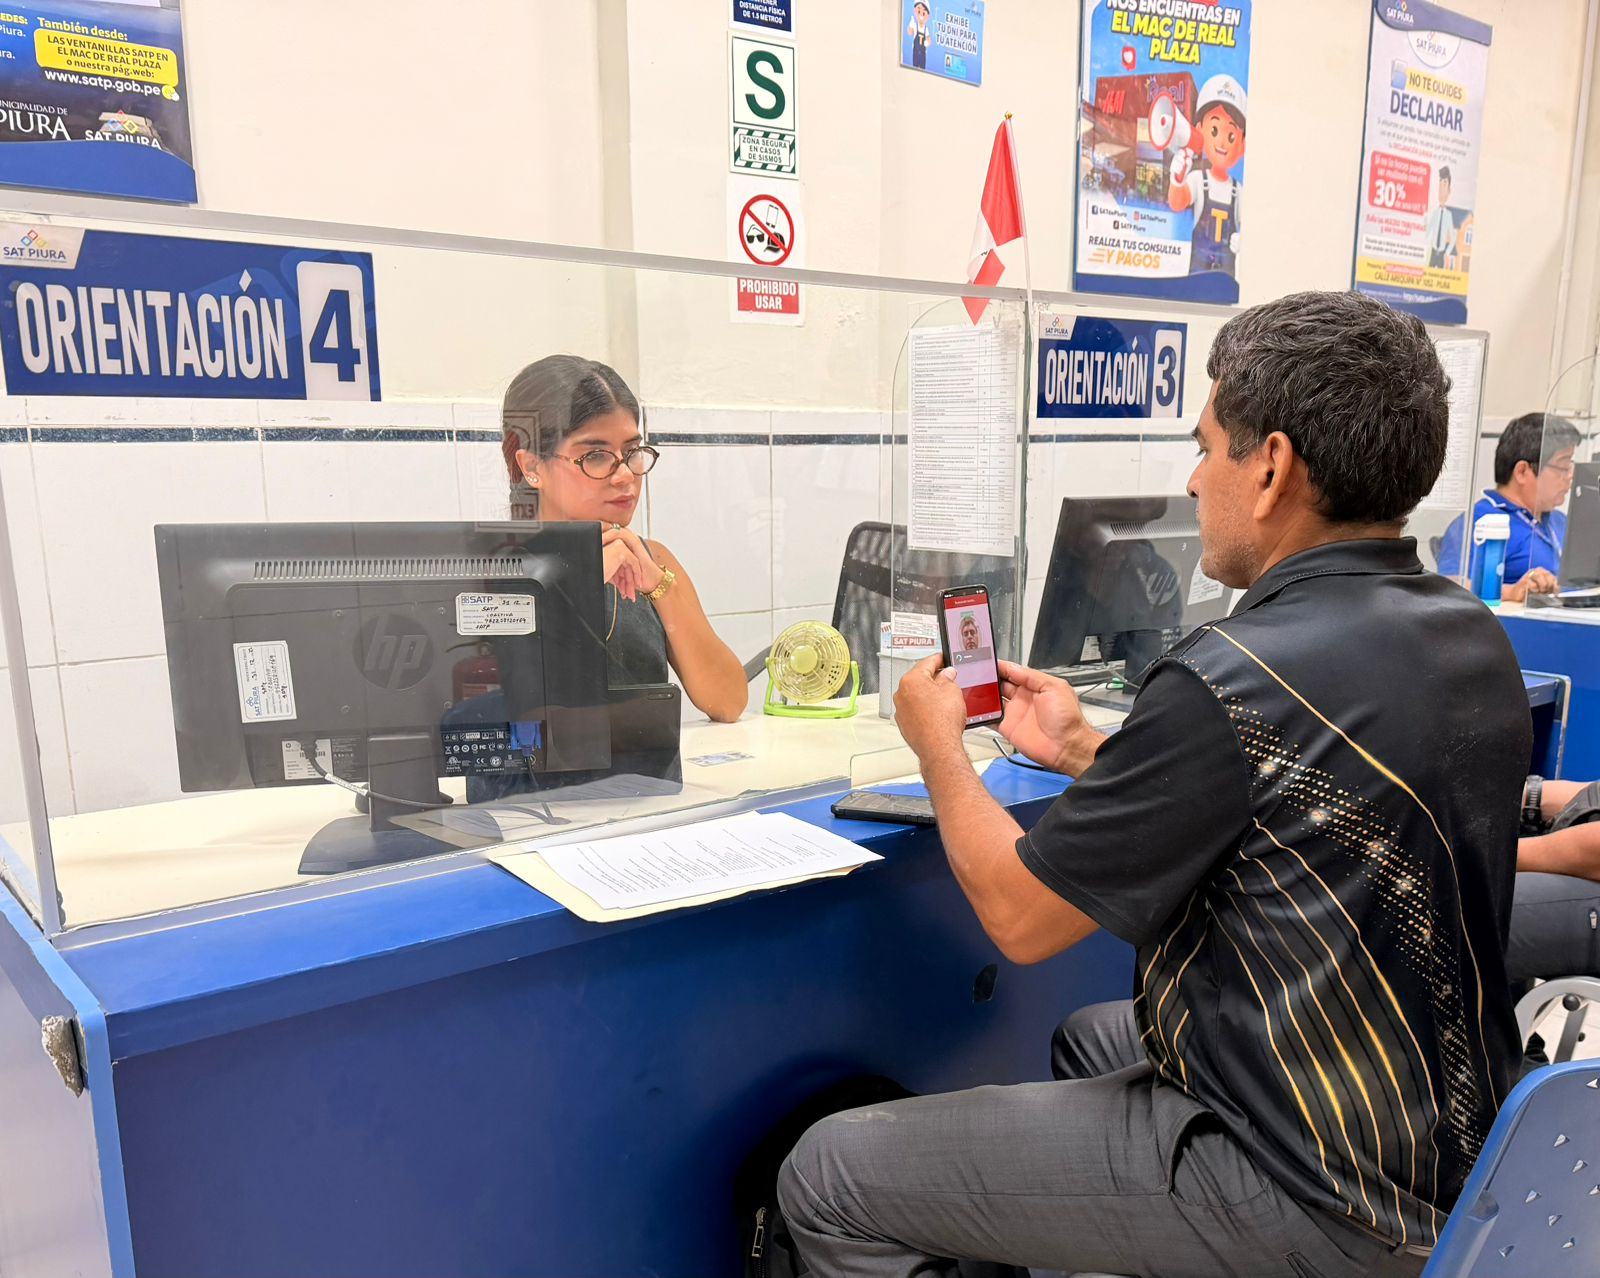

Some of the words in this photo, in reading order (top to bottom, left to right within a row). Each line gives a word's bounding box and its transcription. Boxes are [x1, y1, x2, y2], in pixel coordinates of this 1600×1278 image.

[0, 12, 28, 25] EDES:
[739, 1, 767, 12] DISTANCIA
[768, 6, 786, 16] FÍSICA
[760, 13, 783, 24] METROS
[1107, 0, 1138, 11] NOS
[1139, 0, 1223, 23] ENCUENTRAS
[1223, 8, 1241, 25] EN
[1386, 7, 1397, 18] SAT
[1397, 11, 1414, 24] PIURA
[37, 16, 90, 35] También
[91, 25, 128, 41] desde:
[945, 13, 969, 28] EXHIBE
[1111, 10, 1132, 33] EL
[1132, 13, 1173, 39] MAC
[1173, 19, 1197, 41] DE
[1197, 22, 1236, 47] REAL
[937, 22, 946, 33] TU
[947, 26, 959, 36] DNI
[960, 28, 977, 41] PARA
[48, 35, 65, 45] LAS
[66, 38, 131, 57] VENTANILLAS
[132, 49, 155, 60] SATP
[156, 53, 169, 61] EN
[936, 33, 945, 44] TU
[946, 36, 978, 54] ATENCIÓN
[1150, 38, 1200, 64] PLAZA
[1416, 38, 1428, 49] SAT
[57, 47, 69, 56] EL
[69, 48, 92, 59] MAC
[93, 52, 106, 62] DE
[108, 55, 131, 65] REAL
[132, 58, 162, 70] PLAZA
[74, 60, 111, 72] nuestra
[45, 70, 161, 97] www.satp.gob.pe
[745, 50, 785, 120] S
[1409, 72, 1421, 88] NO
[1422, 76, 1432, 92] TE
[1432, 80, 1463, 100] OLVIDES
[57, 107, 68, 116] DE
[1390, 90, 1463, 132] DECLARAR
[742, 136, 760, 145] ZONA
[762, 139, 787, 148] SEGURA
[760, 147, 780, 155] CASOS
[759, 154, 782, 163] SISMOS
[1373, 179, 1407, 208] 30%
[1211, 207, 1229, 243] T
[3, 246, 26, 257] SAT
[28, 248, 67, 260] PIURA
[1088, 235, 1121, 248] REALIZA
[1123, 239, 1137, 250] TUS
[1138, 242, 1182, 255] CONSULTAS
[1106, 249, 1114, 264] Y
[1116, 250, 1161, 269] PAGOS
[740, 279, 796, 296] PROHIBIDO
[755, 295, 783, 310] USAR
[16, 269, 288, 379] ORIENTACIÓN
[309, 289, 361, 382] 4
[1045, 336, 1148, 405] ORIENTACIÓN
[1155, 345, 1177, 407] 3
[469, 595, 493, 604] SATP
[893, 637, 909, 645] SAT
[910, 638, 932, 646] PIURA
[363, 614, 427, 690] hp
